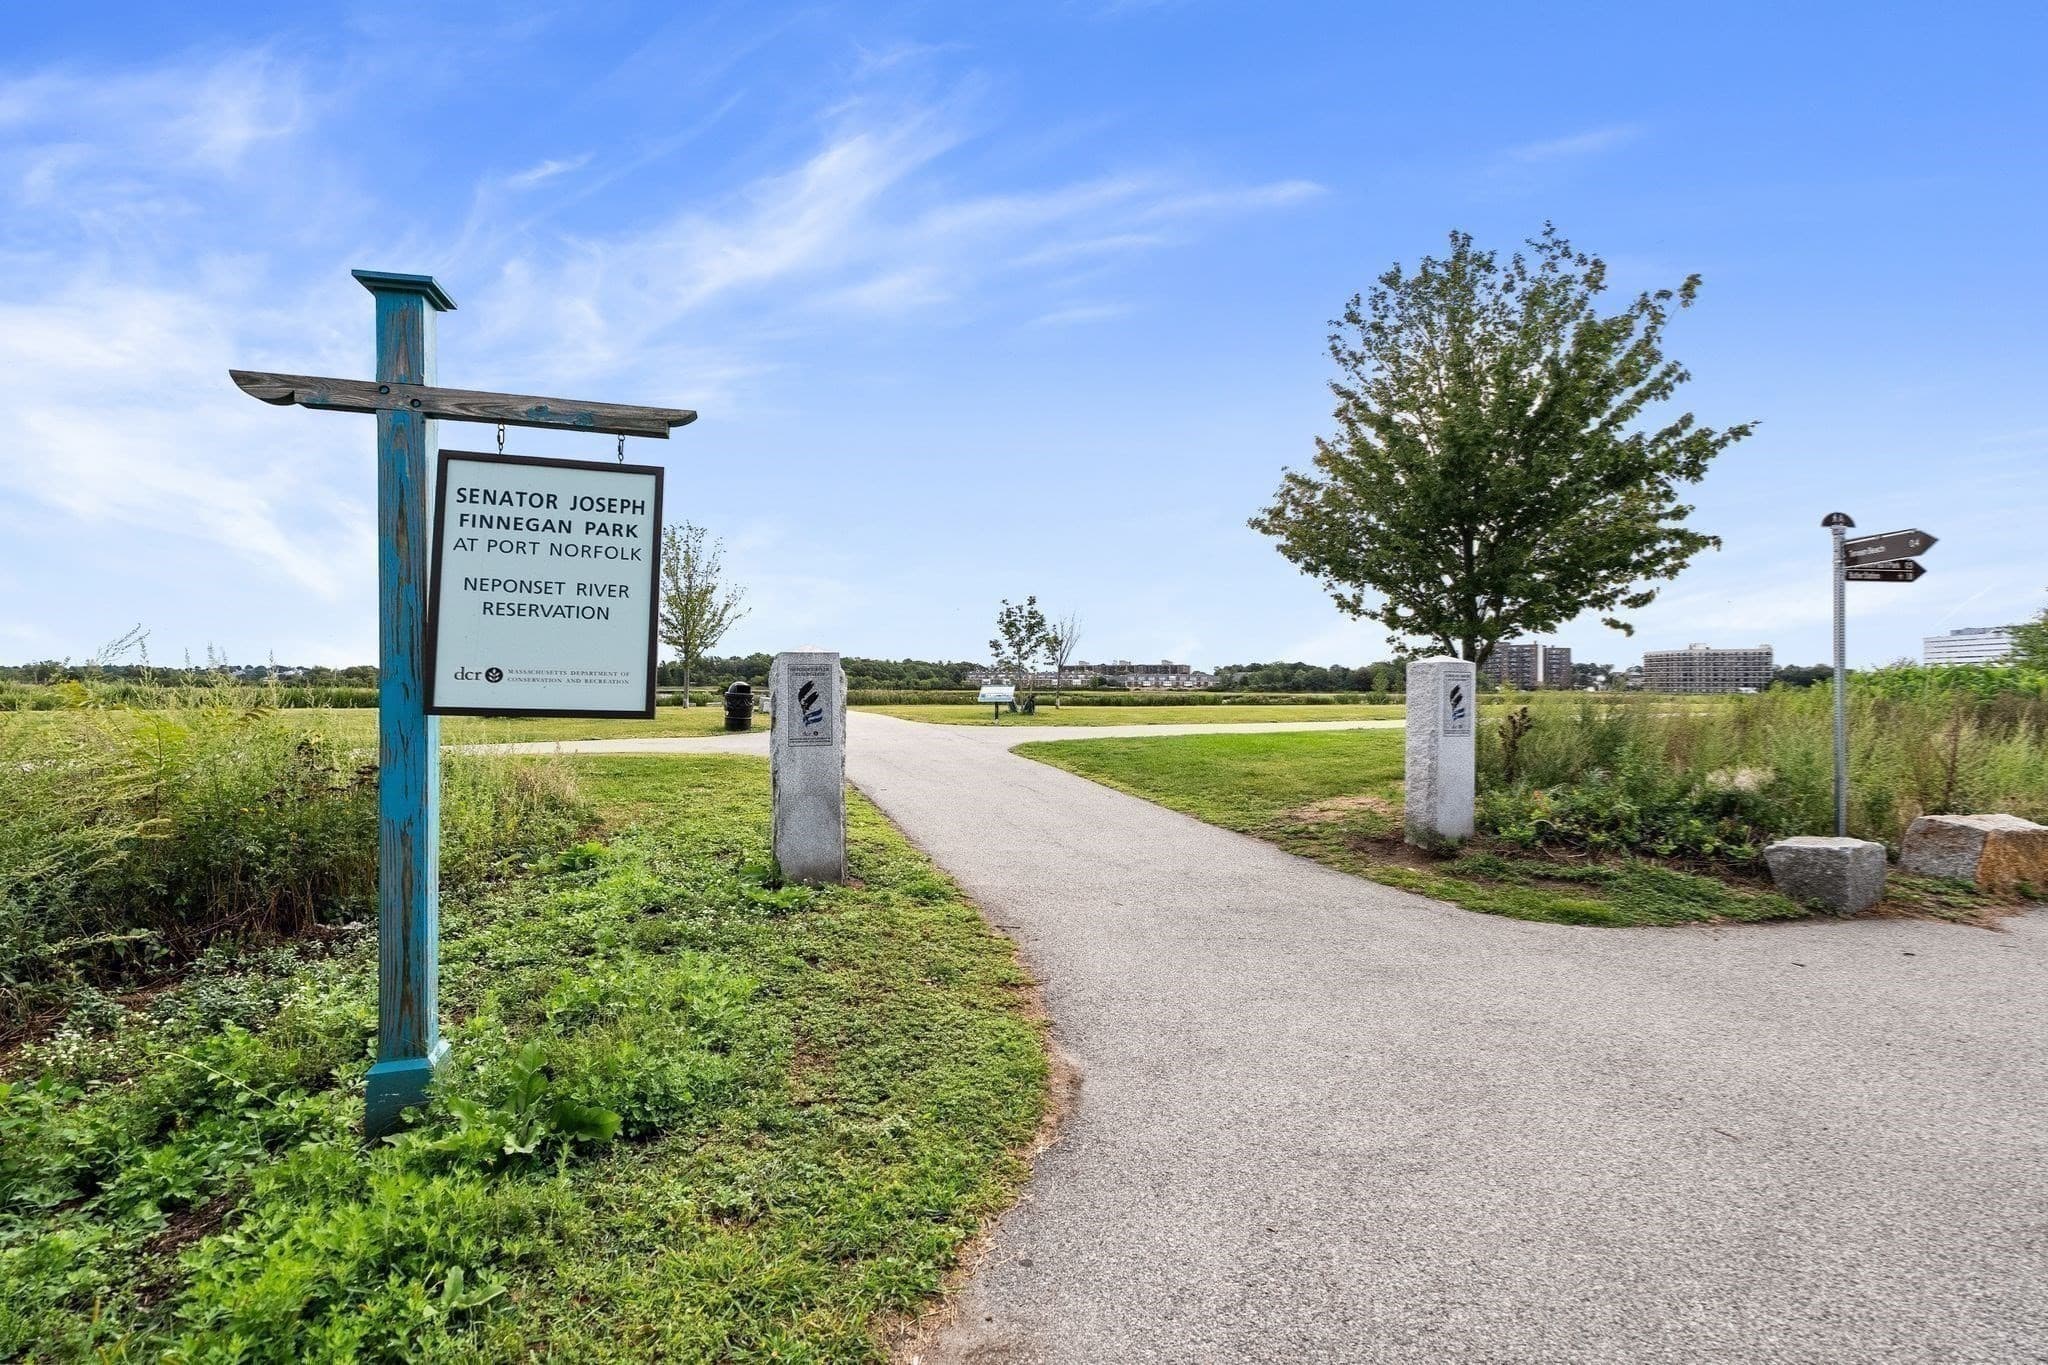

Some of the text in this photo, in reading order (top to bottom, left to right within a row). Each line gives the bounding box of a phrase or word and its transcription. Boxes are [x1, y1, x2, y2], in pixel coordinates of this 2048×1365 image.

[455, 487, 645, 516] SENATOR JOSEPH
[459, 513, 639, 539] FINNEGAN PARK
[453, 537, 642, 562] AT PORT NORFOLK
[463, 577, 630, 599] NEPONSET RIVER
[482, 601, 610, 621] RESERVATION
[454, 666, 482, 681] dcr
[507, 668, 568, 676] MASSACHUSETTS
